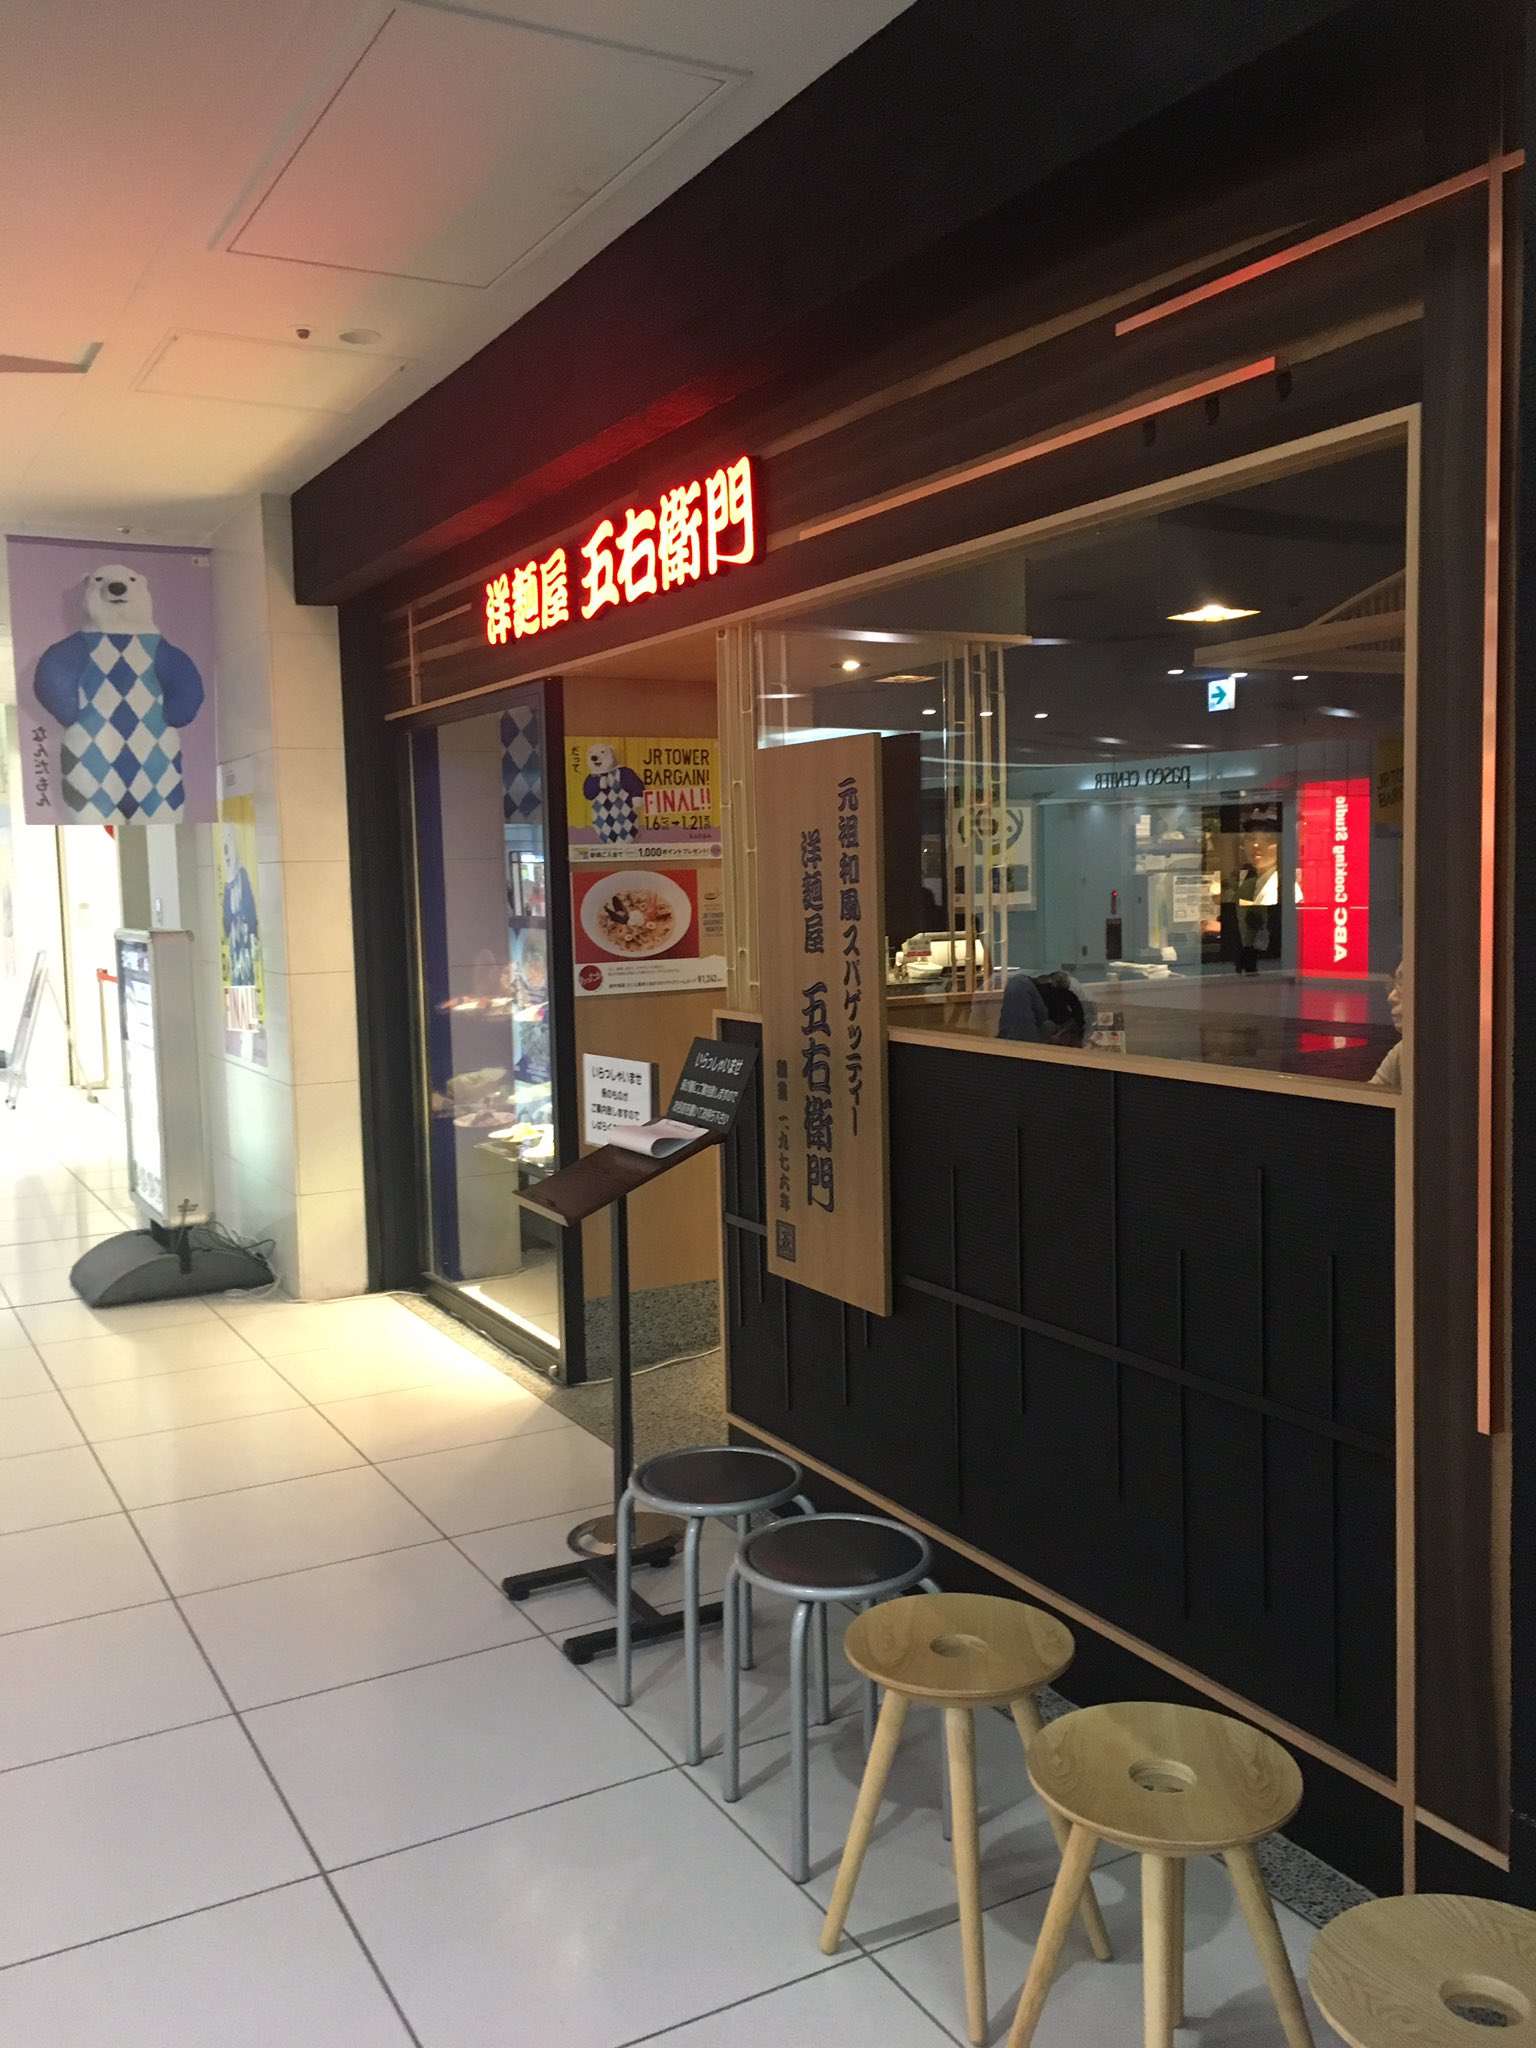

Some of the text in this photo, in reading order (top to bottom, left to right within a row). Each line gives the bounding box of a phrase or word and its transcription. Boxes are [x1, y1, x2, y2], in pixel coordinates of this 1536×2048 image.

[581, 456, 754, 619] 五右衛門
[643, 748, 709, 765] JR TOWER
[644, 769, 709, 785] BARGAIN!
[644, 788, 711, 814] FINAL!!
[645, 816, 660, 830] 1.6
[592, 1066, 642, 1086] いらっしゃいませ
[801, 981, 835, 1213] 五右衛門
